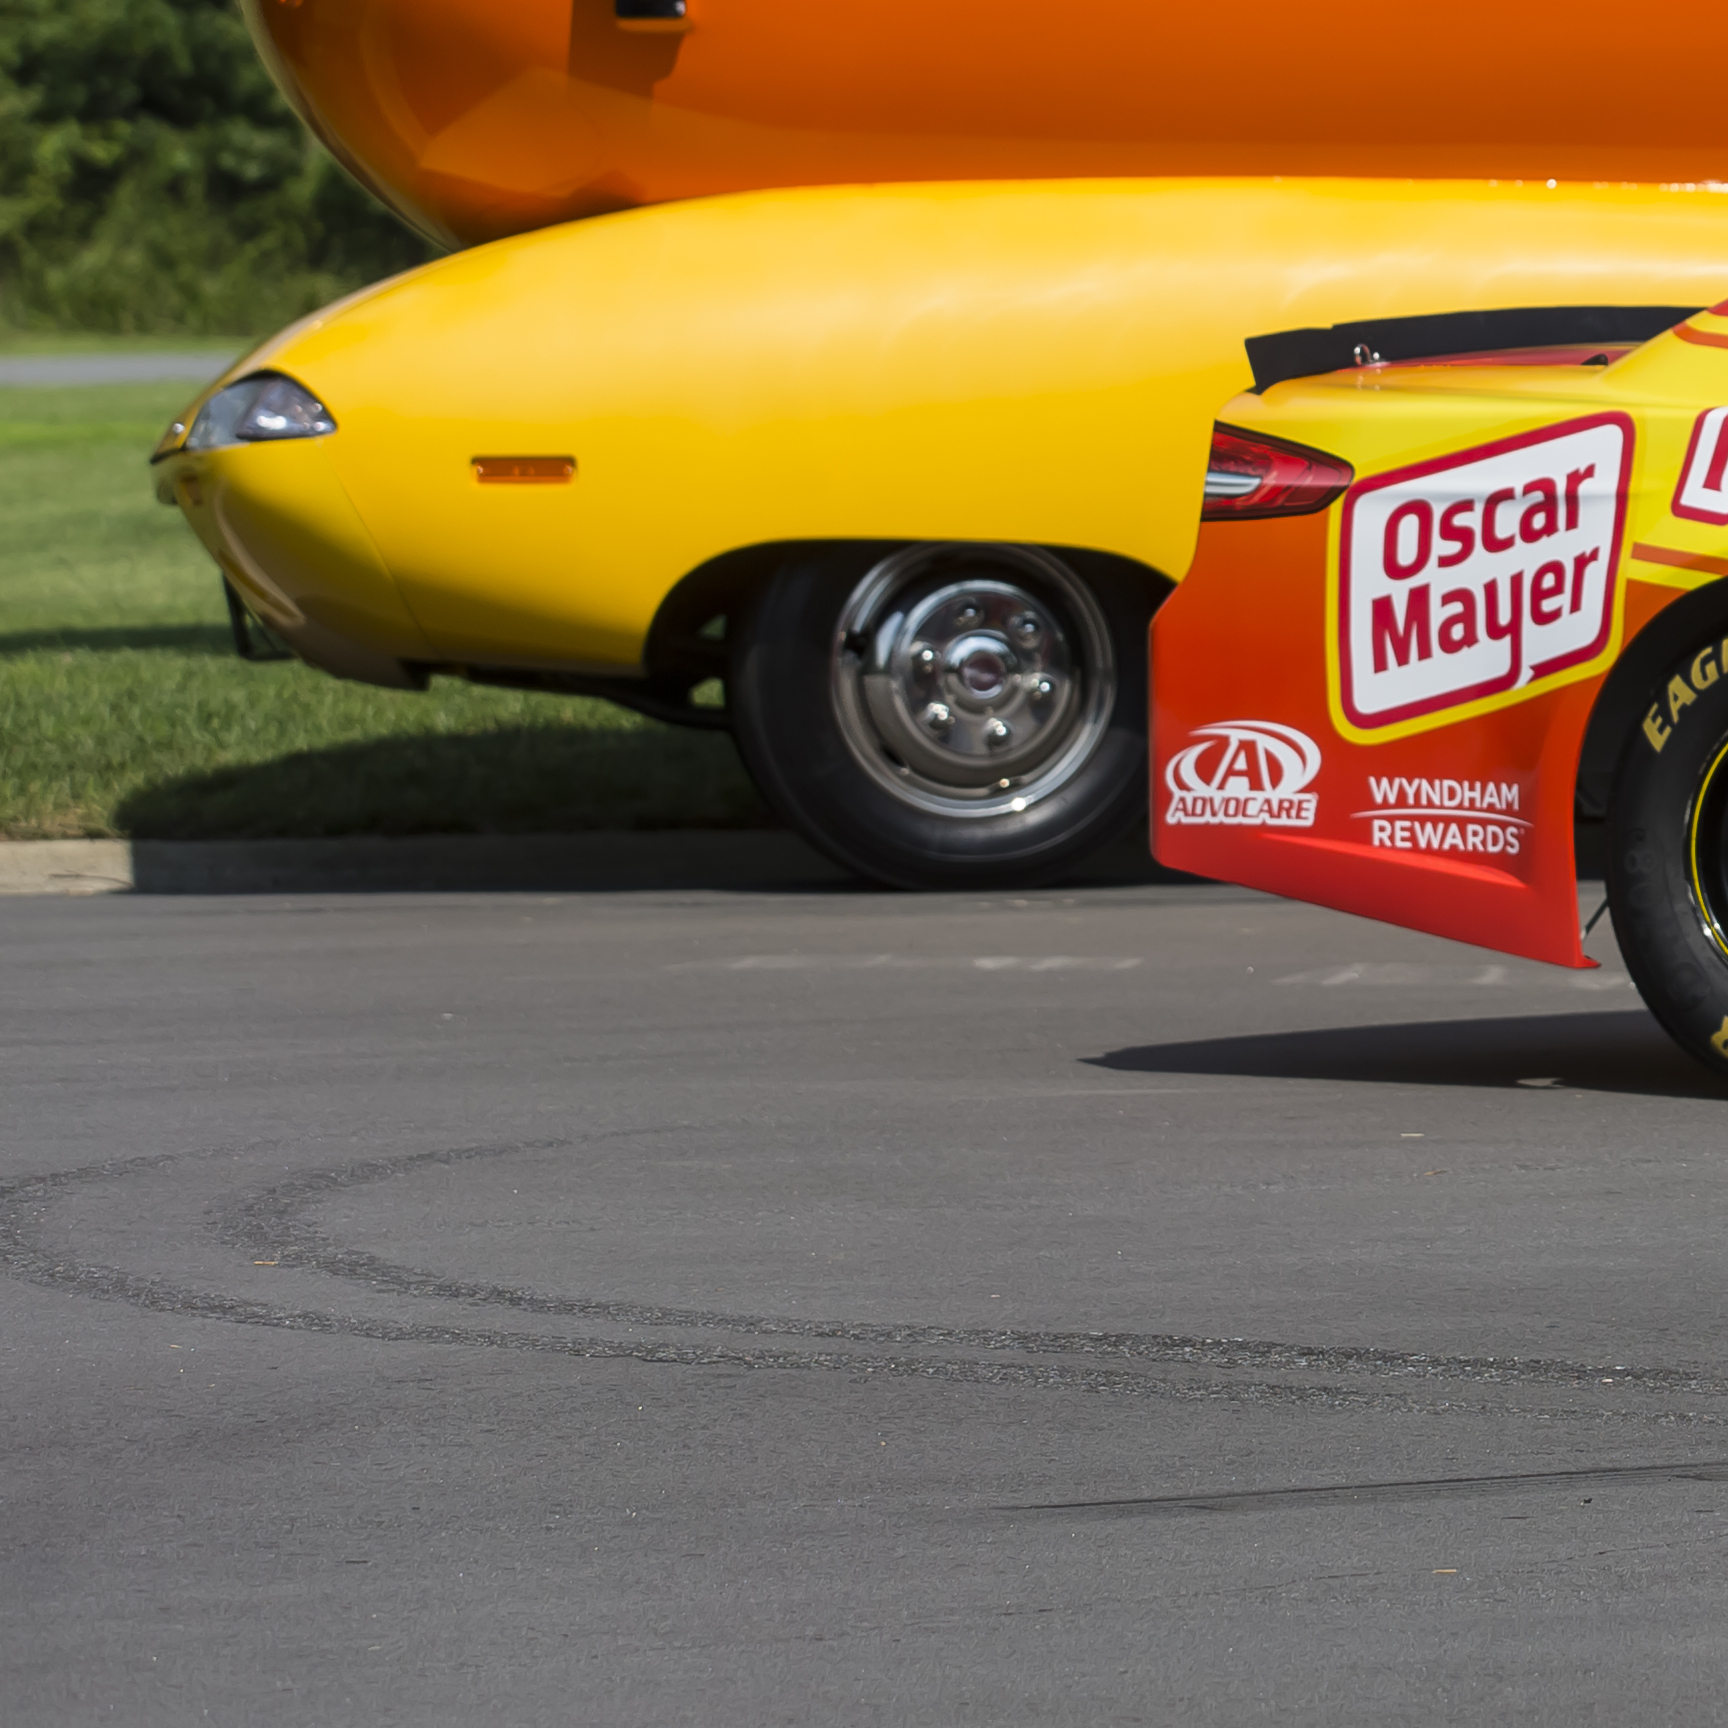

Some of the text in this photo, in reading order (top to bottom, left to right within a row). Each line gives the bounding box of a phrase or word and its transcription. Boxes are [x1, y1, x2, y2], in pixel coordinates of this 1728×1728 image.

[1381, 462, 1598, 581] Oscar
[1370, 544, 1600, 678] Mayer
[1170, 795, 1314, 821] ADVOCARE
[1368, 775, 1521, 813] WYNDHAM
[1371, 819, 1521, 856] REWARDS
